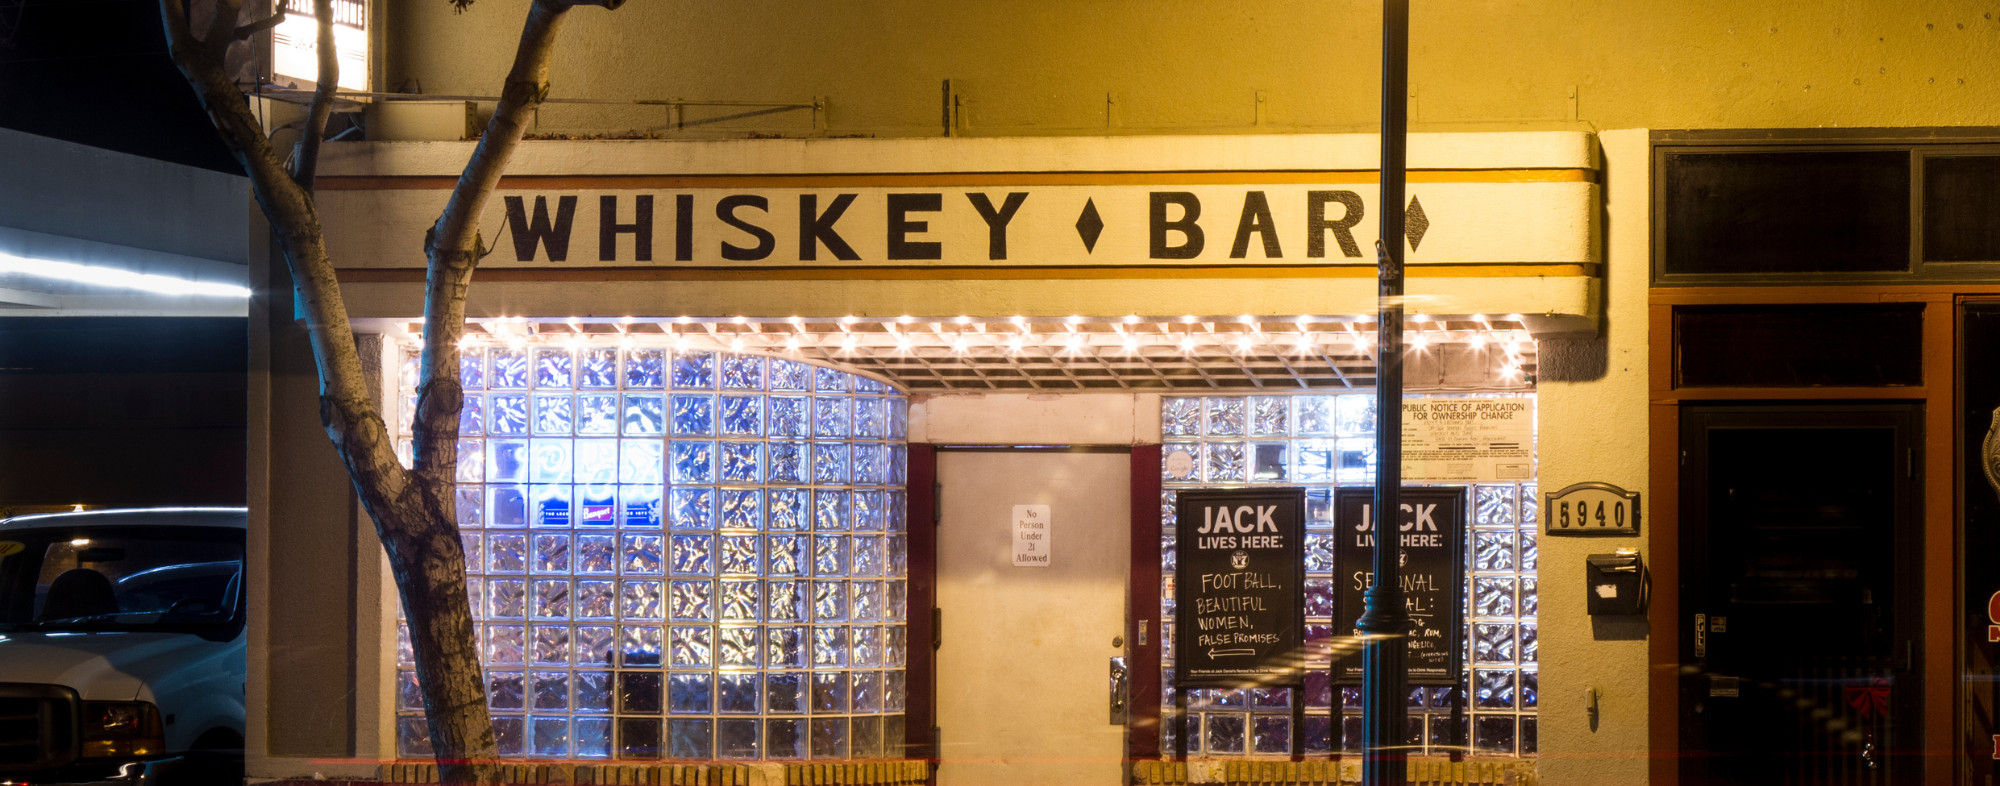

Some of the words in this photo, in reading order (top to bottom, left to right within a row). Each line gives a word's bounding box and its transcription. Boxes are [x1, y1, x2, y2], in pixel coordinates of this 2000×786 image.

[503, 190, 1029, 263] WHISKEY
[1149, 189, 1365, 260] BAR
[1402, 403, 1427, 412] PUBLIC
[1430, 403, 1458, 412] NOTICE
[1461, 403, 1473, 411] OF
[1475, 402, 1525, 411] APPLICATION
[1413, 412, 1428, 420] FOR
[1431, 411, 1477, 420] OWNERSHIP
[1480, 411, 1514, 420] CHANGE
[1026, 509, 1037, 518] No
[1197, 504, 1279, 534] JACK
[1355, 503, 1438, 532] JCK
[1559, 500, 1625, 529] 5940
[1019, 520, 1044, 529] Person
[1020, 530, 1043, 540] Under
[1027, 542, 1035, 551] 21
[1198, 536, 1237, 549] LIVES
[1241, 535, 1284, 549] HERE:
[1016, 553, 1048, 562] Allowed
[1196, 596, 1267, 614] BEAUTIFUL
[1198, 633, 1231, 647] FALSE
[1233, 632, 1280, 645] PROMISES
